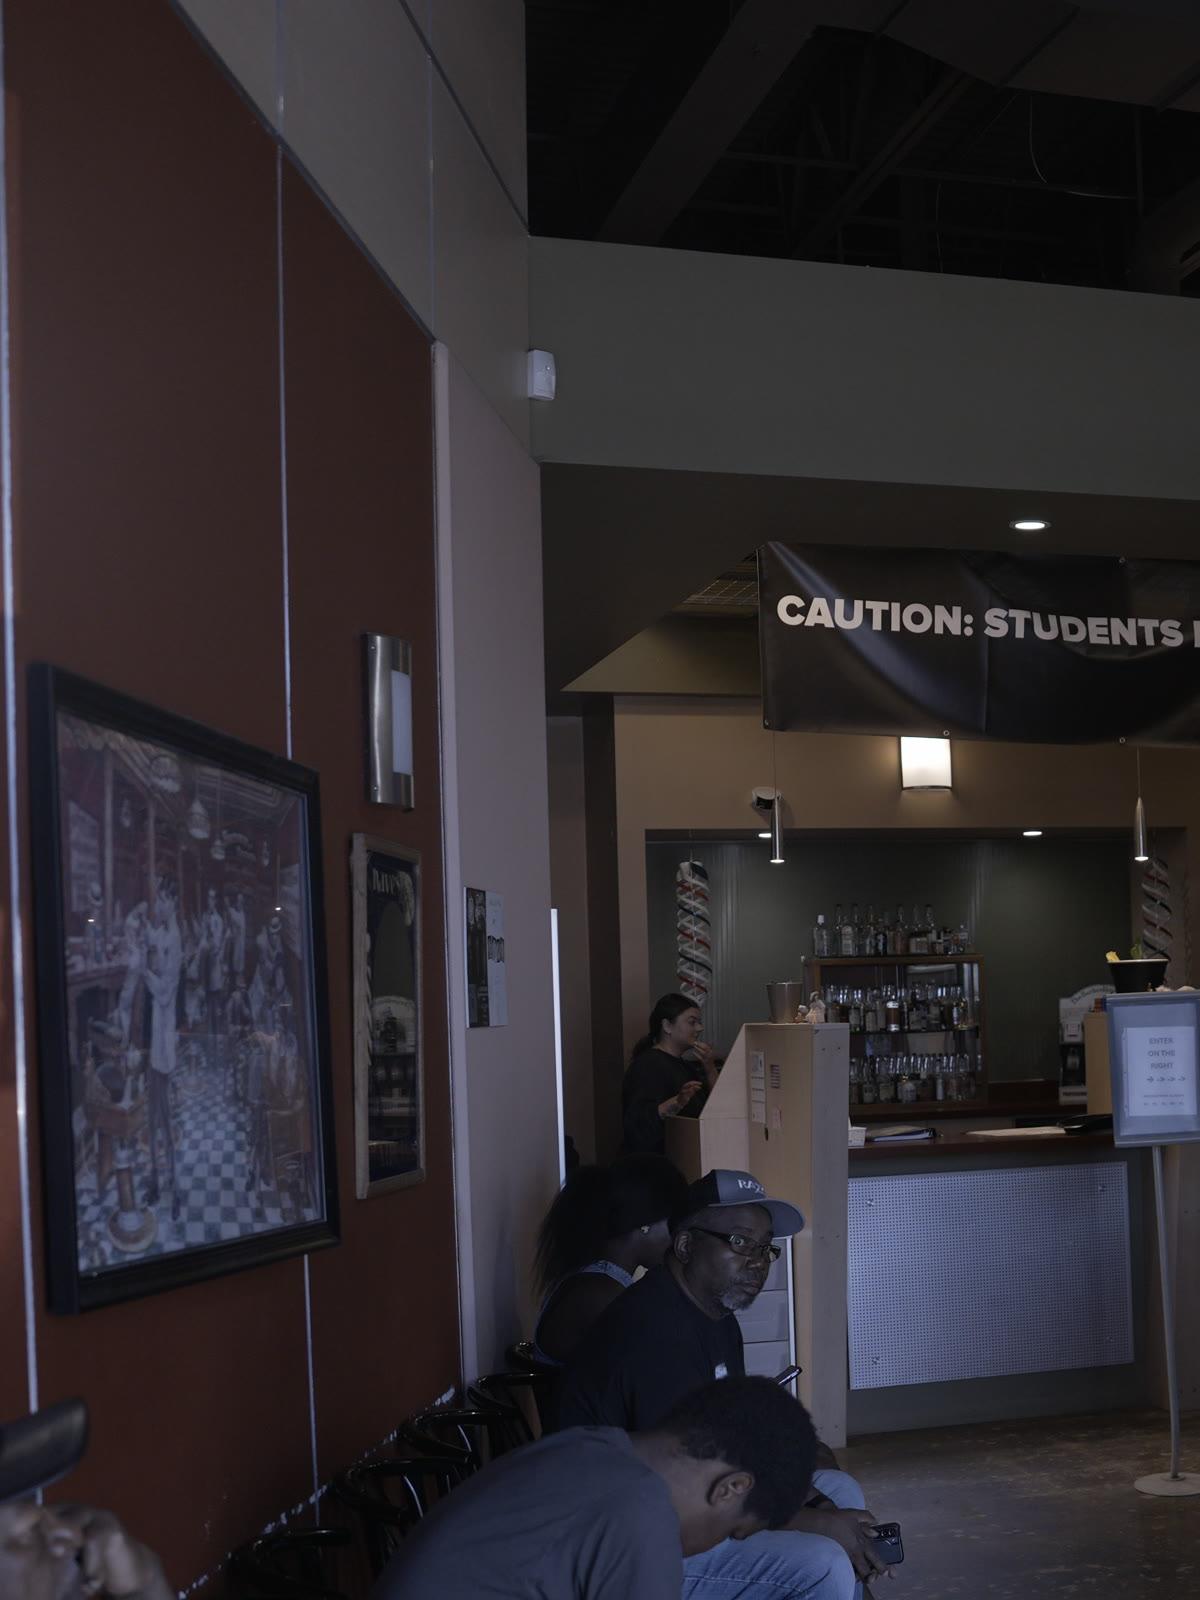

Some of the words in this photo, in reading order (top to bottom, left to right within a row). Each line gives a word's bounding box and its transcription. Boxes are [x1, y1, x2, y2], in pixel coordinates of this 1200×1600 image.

[777, 595, 974, 637] CAUTION:
[984, 608, 1184, 648] STUDENTS
[1149, 1037, 1174, 1045] ENTER
[1147, 1049, 1160, 1057] ON
[1161, 1049, 1176, 1057] THE
